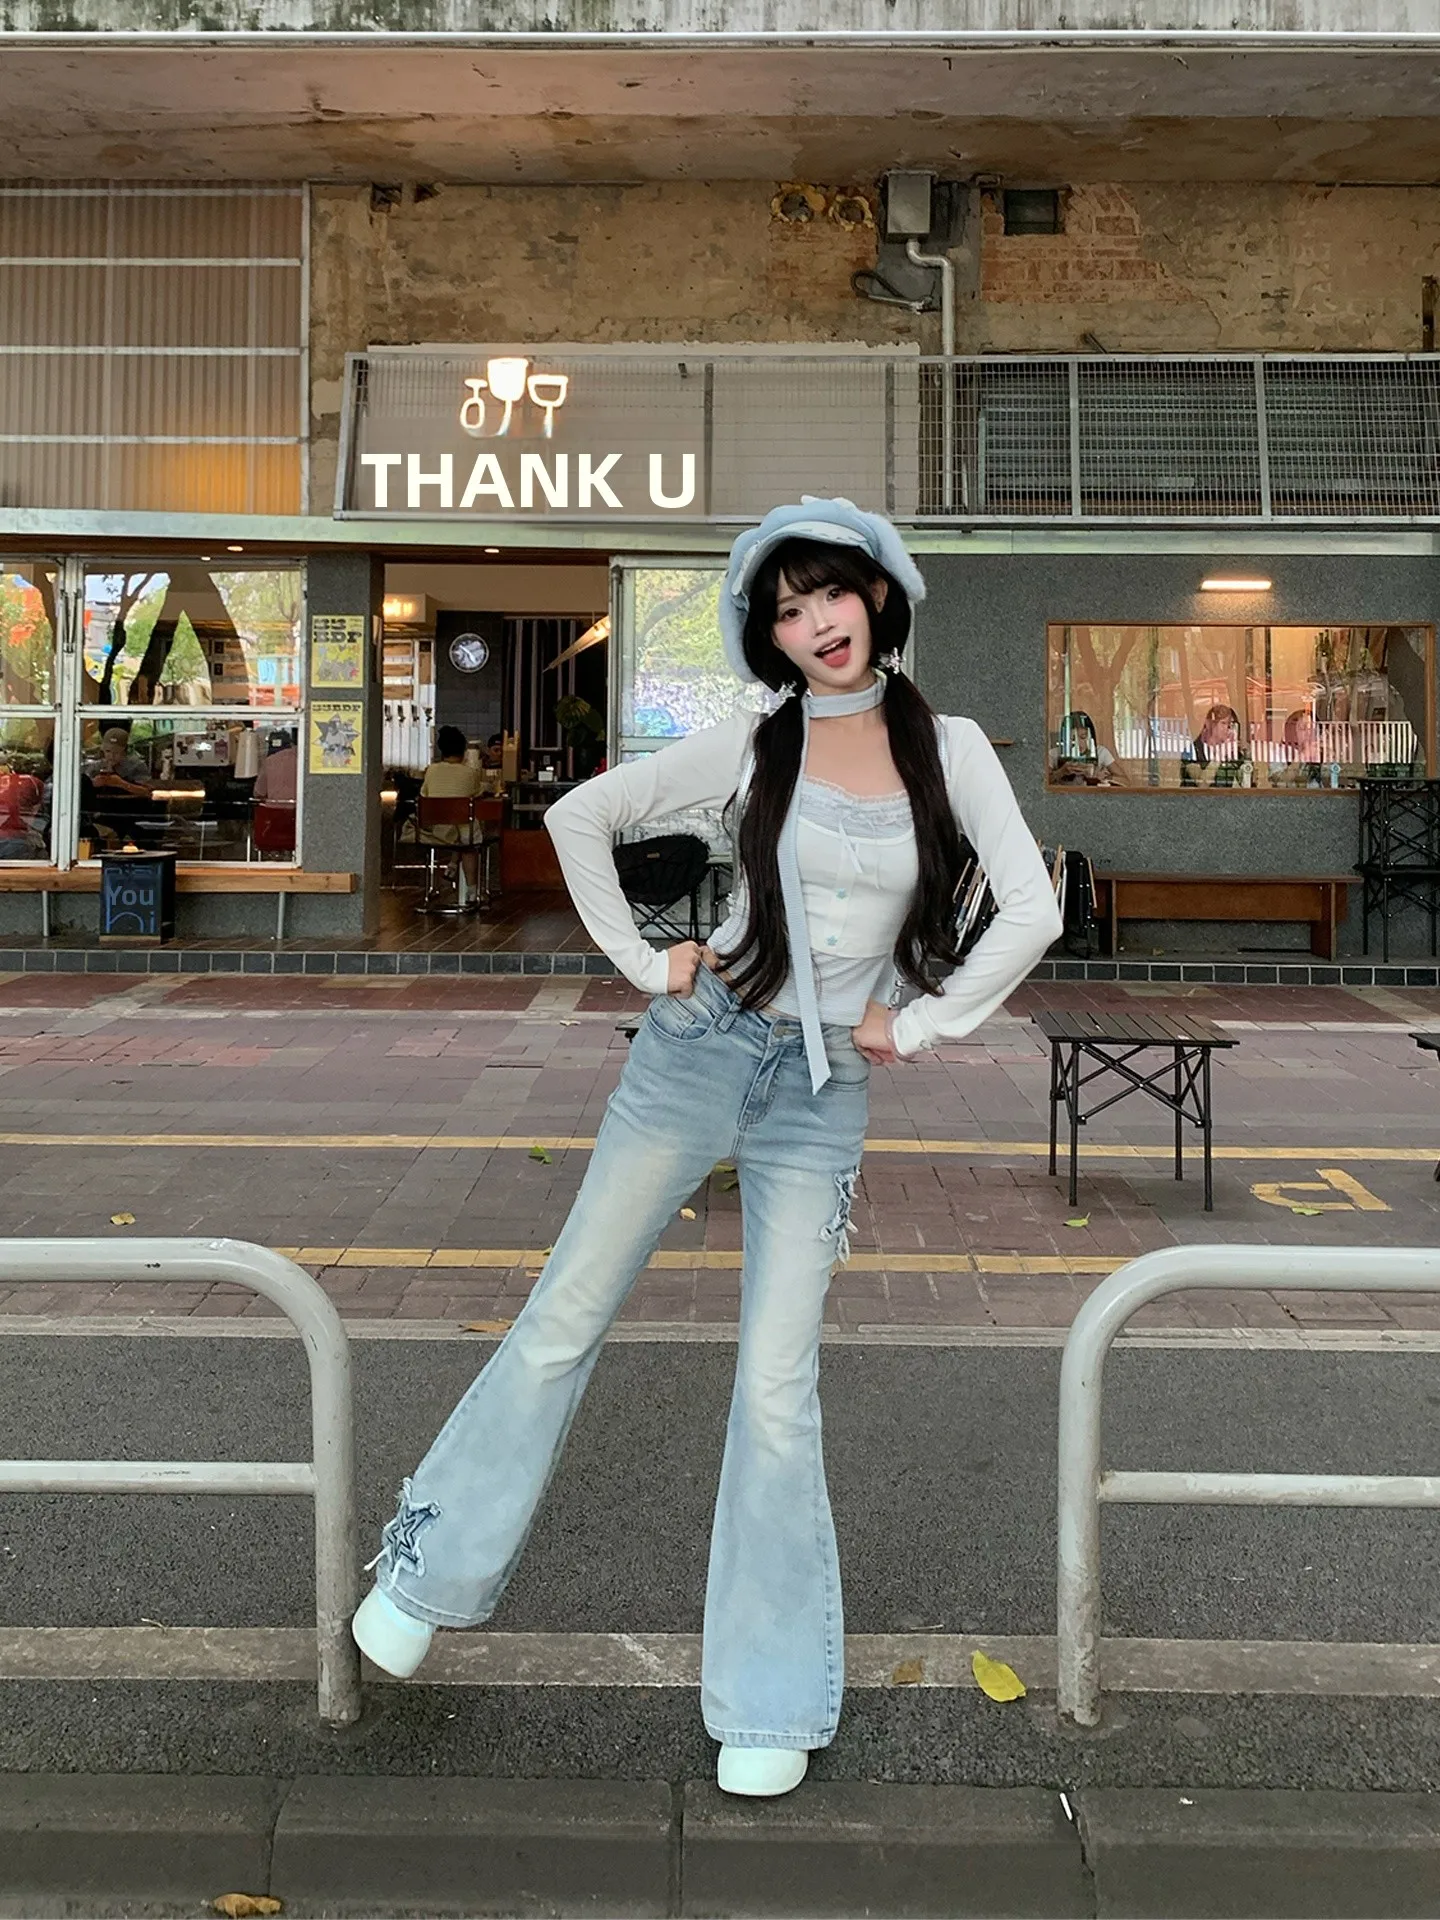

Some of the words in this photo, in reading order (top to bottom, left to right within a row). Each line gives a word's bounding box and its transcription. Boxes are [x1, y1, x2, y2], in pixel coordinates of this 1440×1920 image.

[361, 453, 624, 508] THANK
[649, 453, 696, 509] U
[105, 885, 154, 906] You
